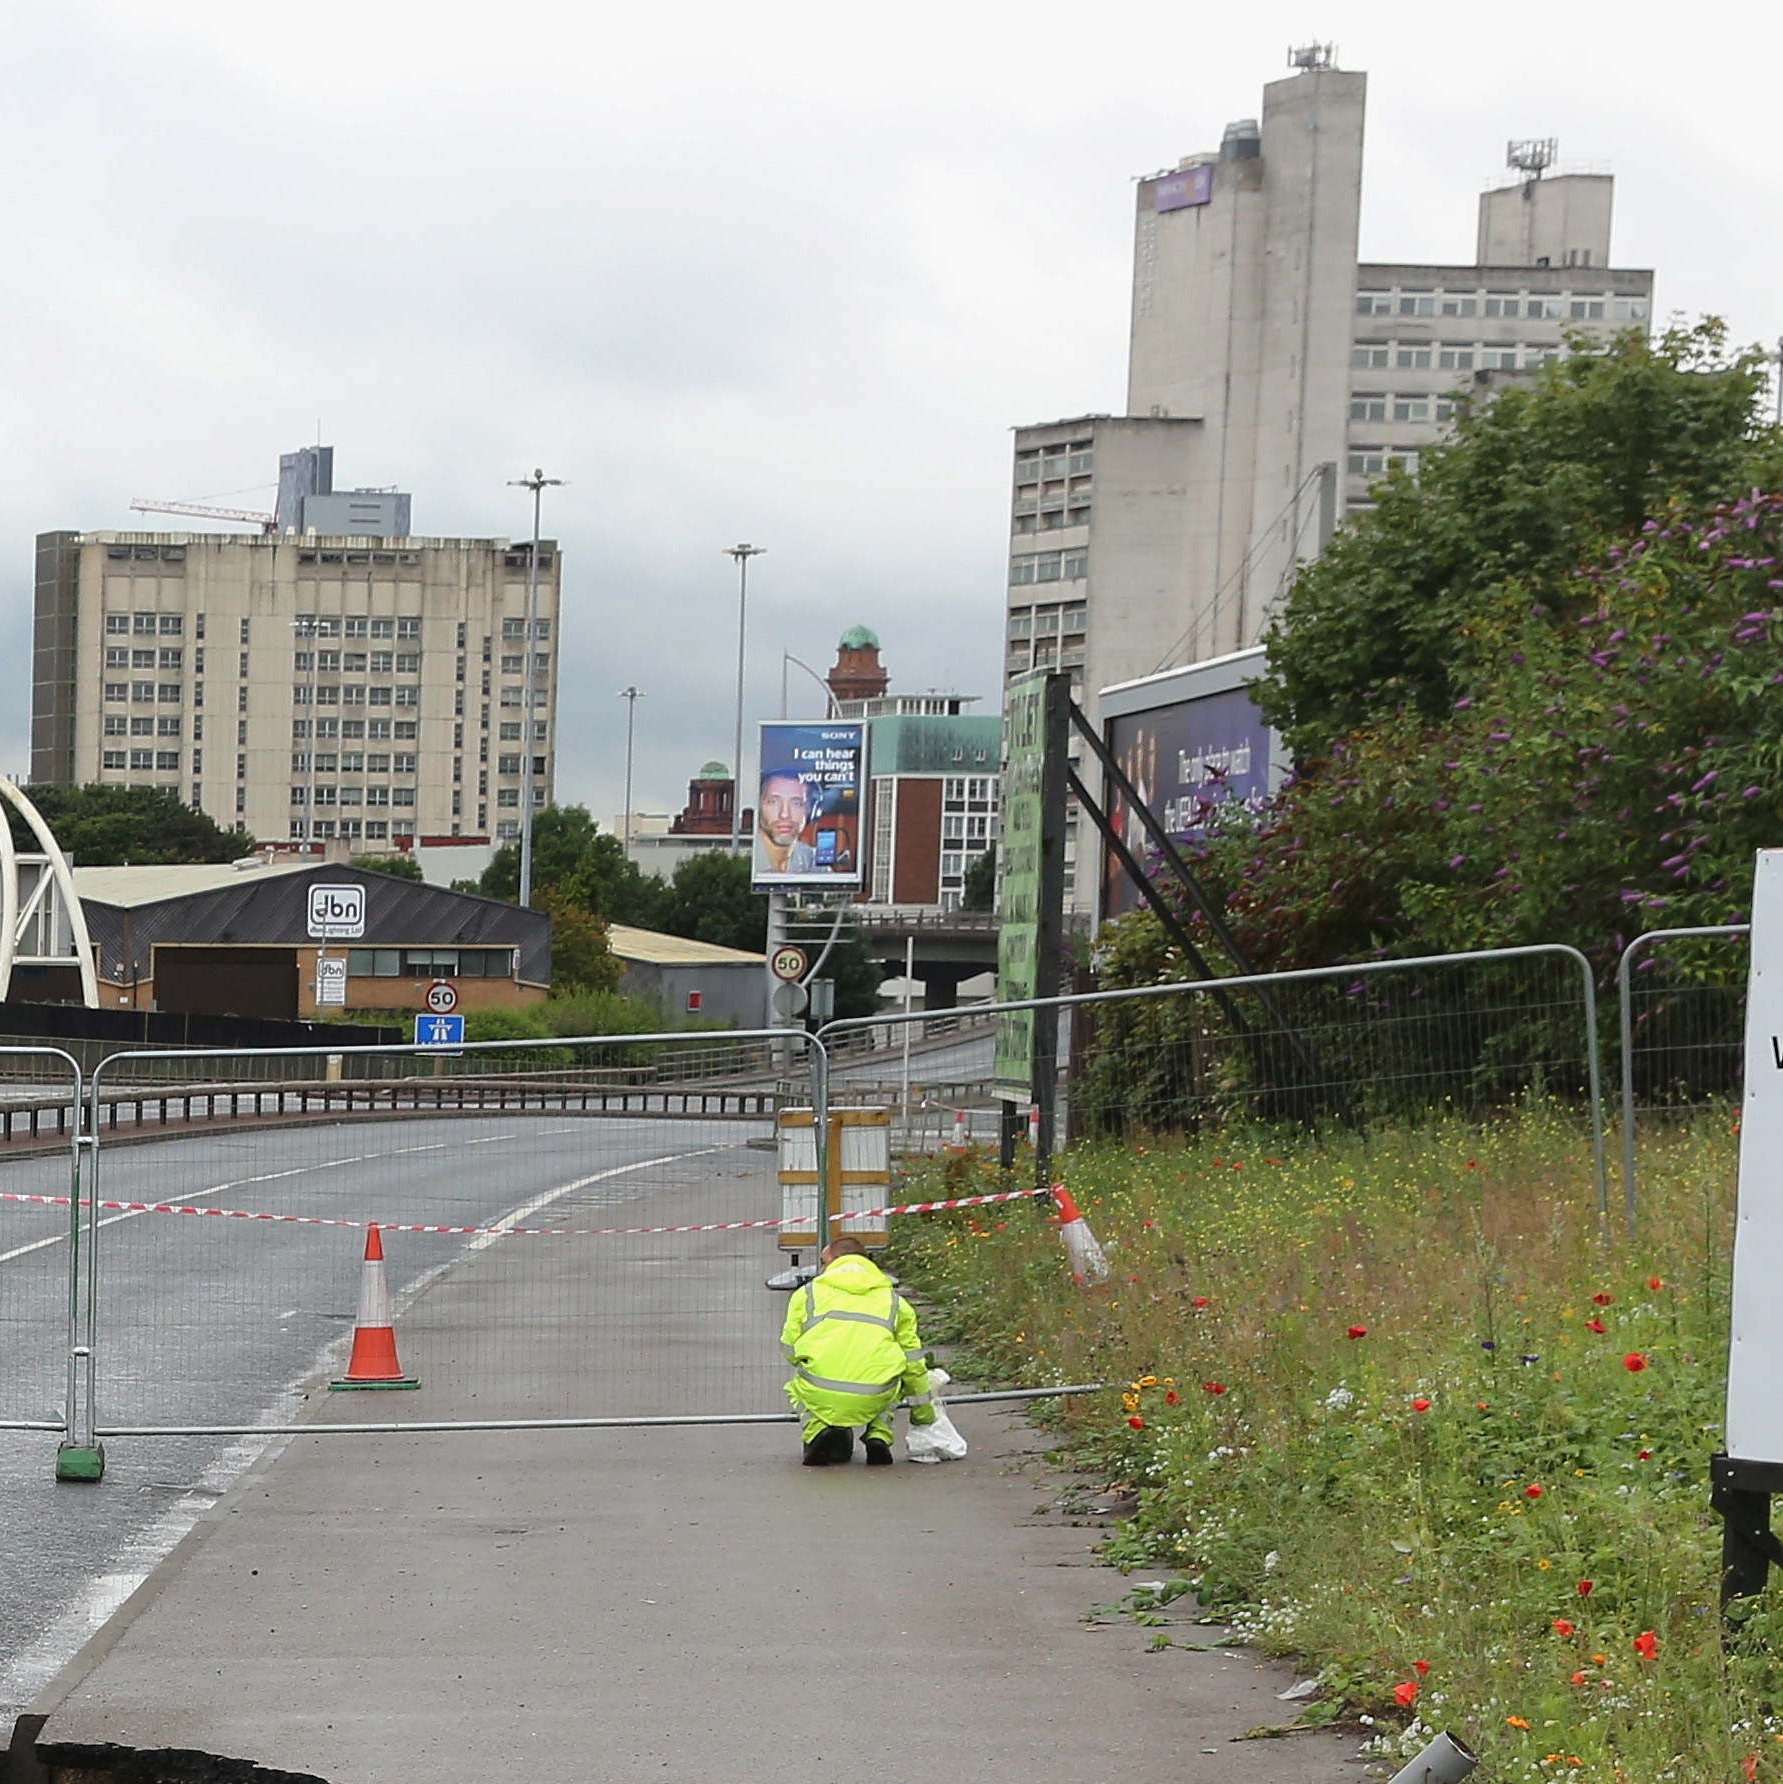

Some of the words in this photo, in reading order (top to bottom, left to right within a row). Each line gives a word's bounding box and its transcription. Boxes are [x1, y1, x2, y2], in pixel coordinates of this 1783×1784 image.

[822, 731, 856, 740] SONY
[794, 748, 799, 759] I
[801, 749, 823, 759] can
[826, 747, 855, 759] hear
[815, 760, 854, 772] things
[798, 773, 821, 784] you
[825, 771, 854, 782] can't
[315, 894, 357, 918] dbn
[778, 957, 801, 971] 50
[430, 991, 454, 1006] 50
